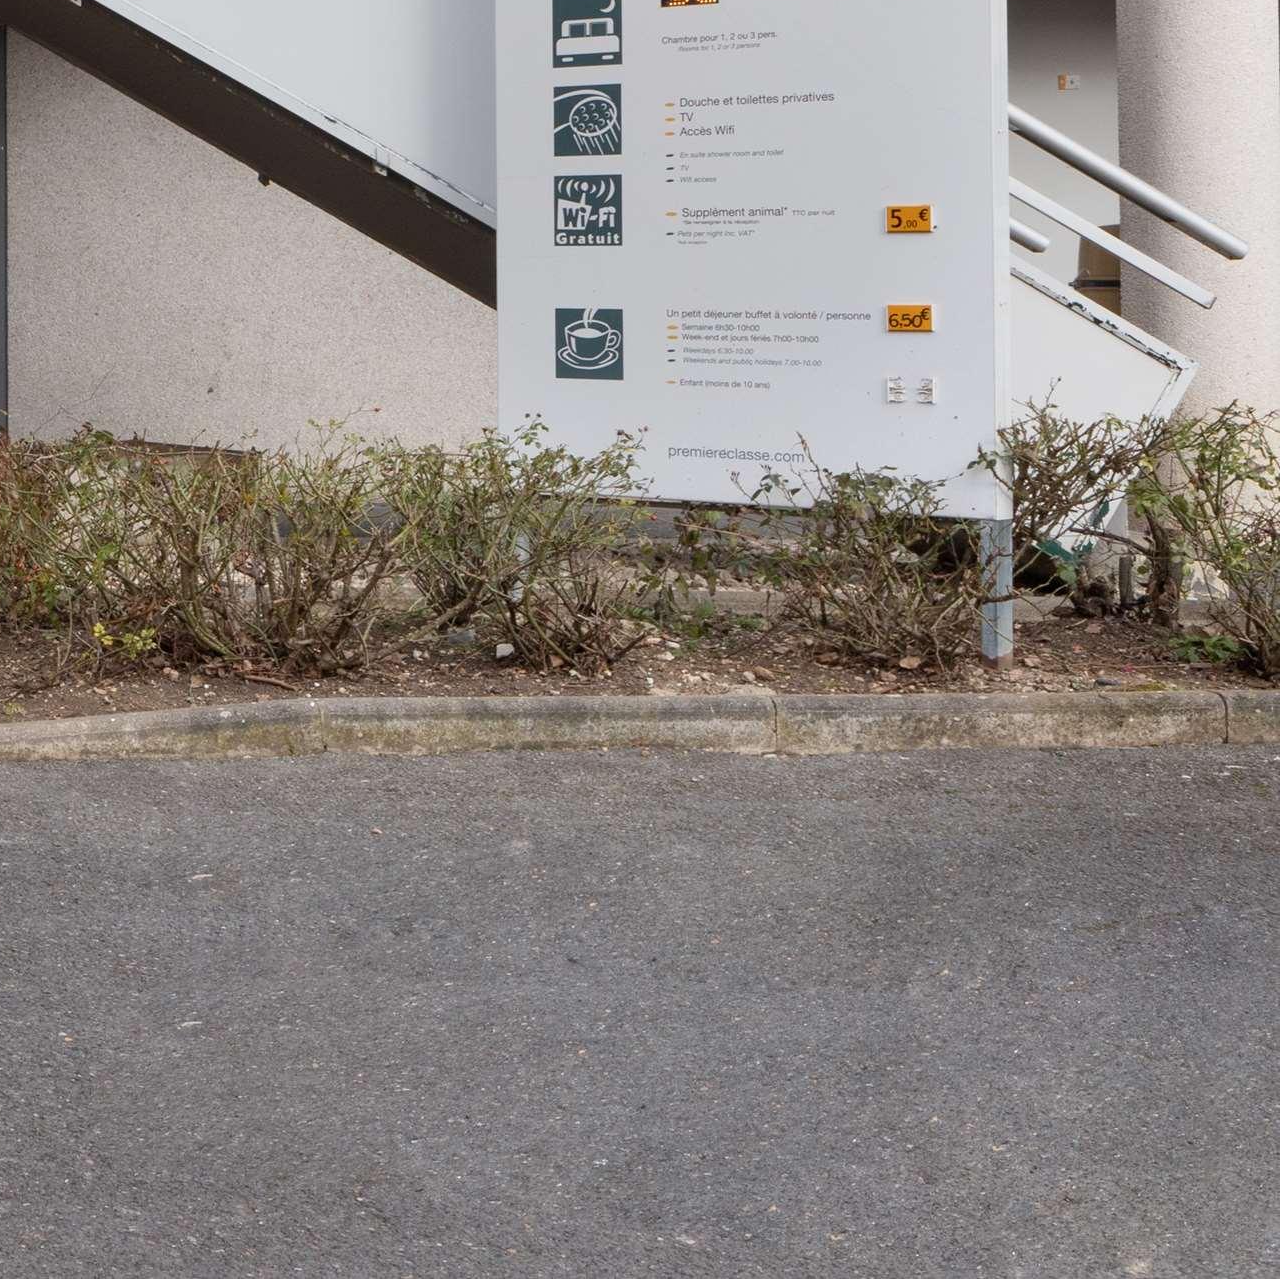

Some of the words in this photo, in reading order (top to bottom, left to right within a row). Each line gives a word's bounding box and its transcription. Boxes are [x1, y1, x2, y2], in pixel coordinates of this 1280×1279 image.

[661, 35, 698, 45] Chambre
[700, 35, 718, 44] pour
[730, 32, 736, 40] 2
[757, 31, 778, 40] pers.
[679, 97, 720, 108] Douche
[723, 96, 733, 106] et
[736, 95, 779, 105] toilettes
[782, 91, 835, 104] privatives
[680, 112, 694, 122] TV
[679, 126, 712, 137] Accès
[715, 125, 735, 136] Wifi
[562, 206, 616, 228] Wi-Fi
[682, 207, 746, 219] Supplément
[555, 232, 620, 245] Gratuit
[666, 310, 679, 318] Un
[681, 310, 701, 319] petit
[703, 310, 743, 319] déjeuner
[744, 310, 772, 319] buffet
[774, 311, 780, 319] à
[782, 311, 818, 320] volonté
[826, 313, 871, 322] personne
[731, 380, 741, 388] de
[744, 380, 753, 389] 10
[668, 446, 805, 463] premiereclasse.com
